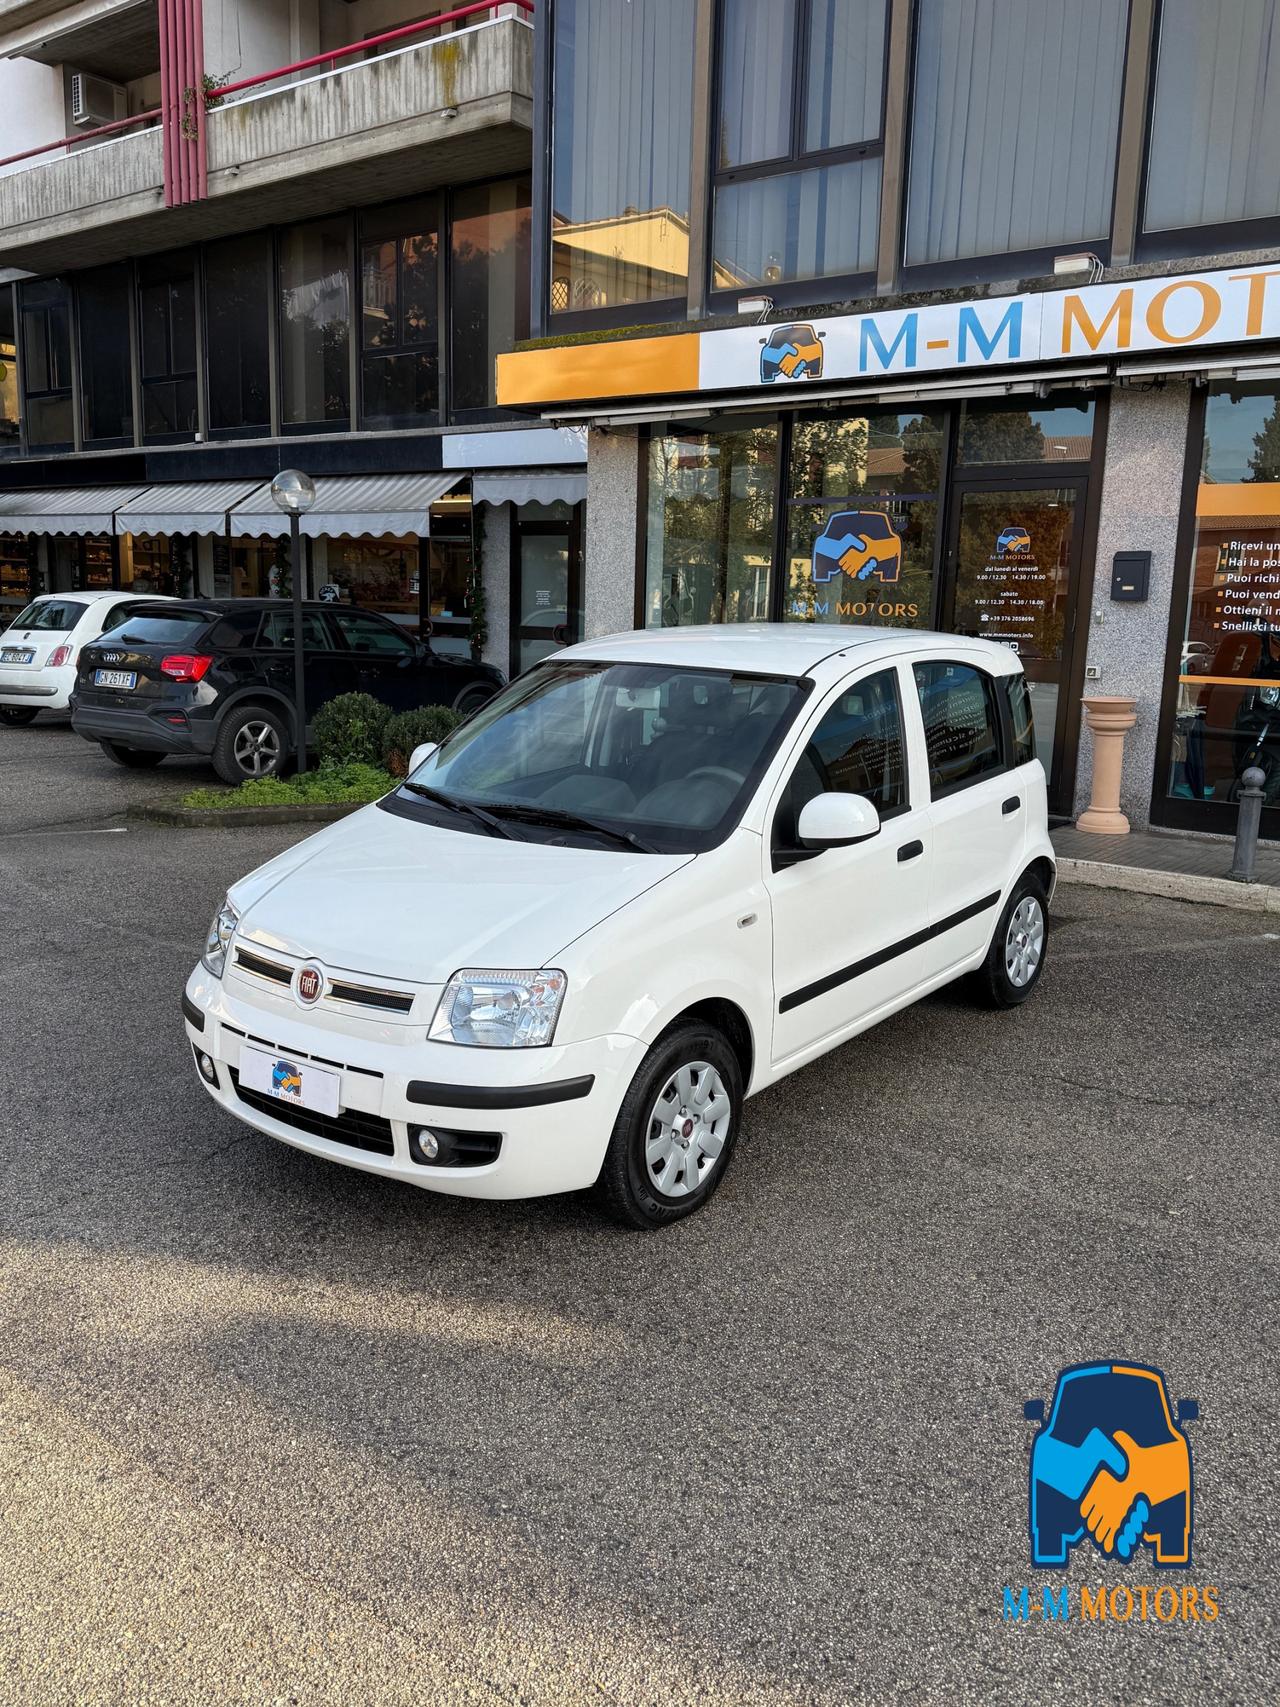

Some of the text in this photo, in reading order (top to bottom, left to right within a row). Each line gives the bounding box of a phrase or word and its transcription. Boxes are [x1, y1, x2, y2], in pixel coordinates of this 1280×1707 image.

[860, 271, 1280, 372] M-M MOT
[1230, 541, 1263, 551] Ricevi
[1228, 557, 1246, 567] Hai
[1250, 557, 1259, 567] la
[1226, 573, 1280, 583] Puoi richi
[1225, 589, 1280, 599] Puoi vend
[835, 602, 919, 617] MOTORS
[1223, 605, 1262, 616] Ottieni
[1265, 605, 1272, 615] il
[1221, 621, 1267, 632] Snellisci
[301, 976, 317, 994] FIAT
[280, 1092, 305, 1106] MOTORS
